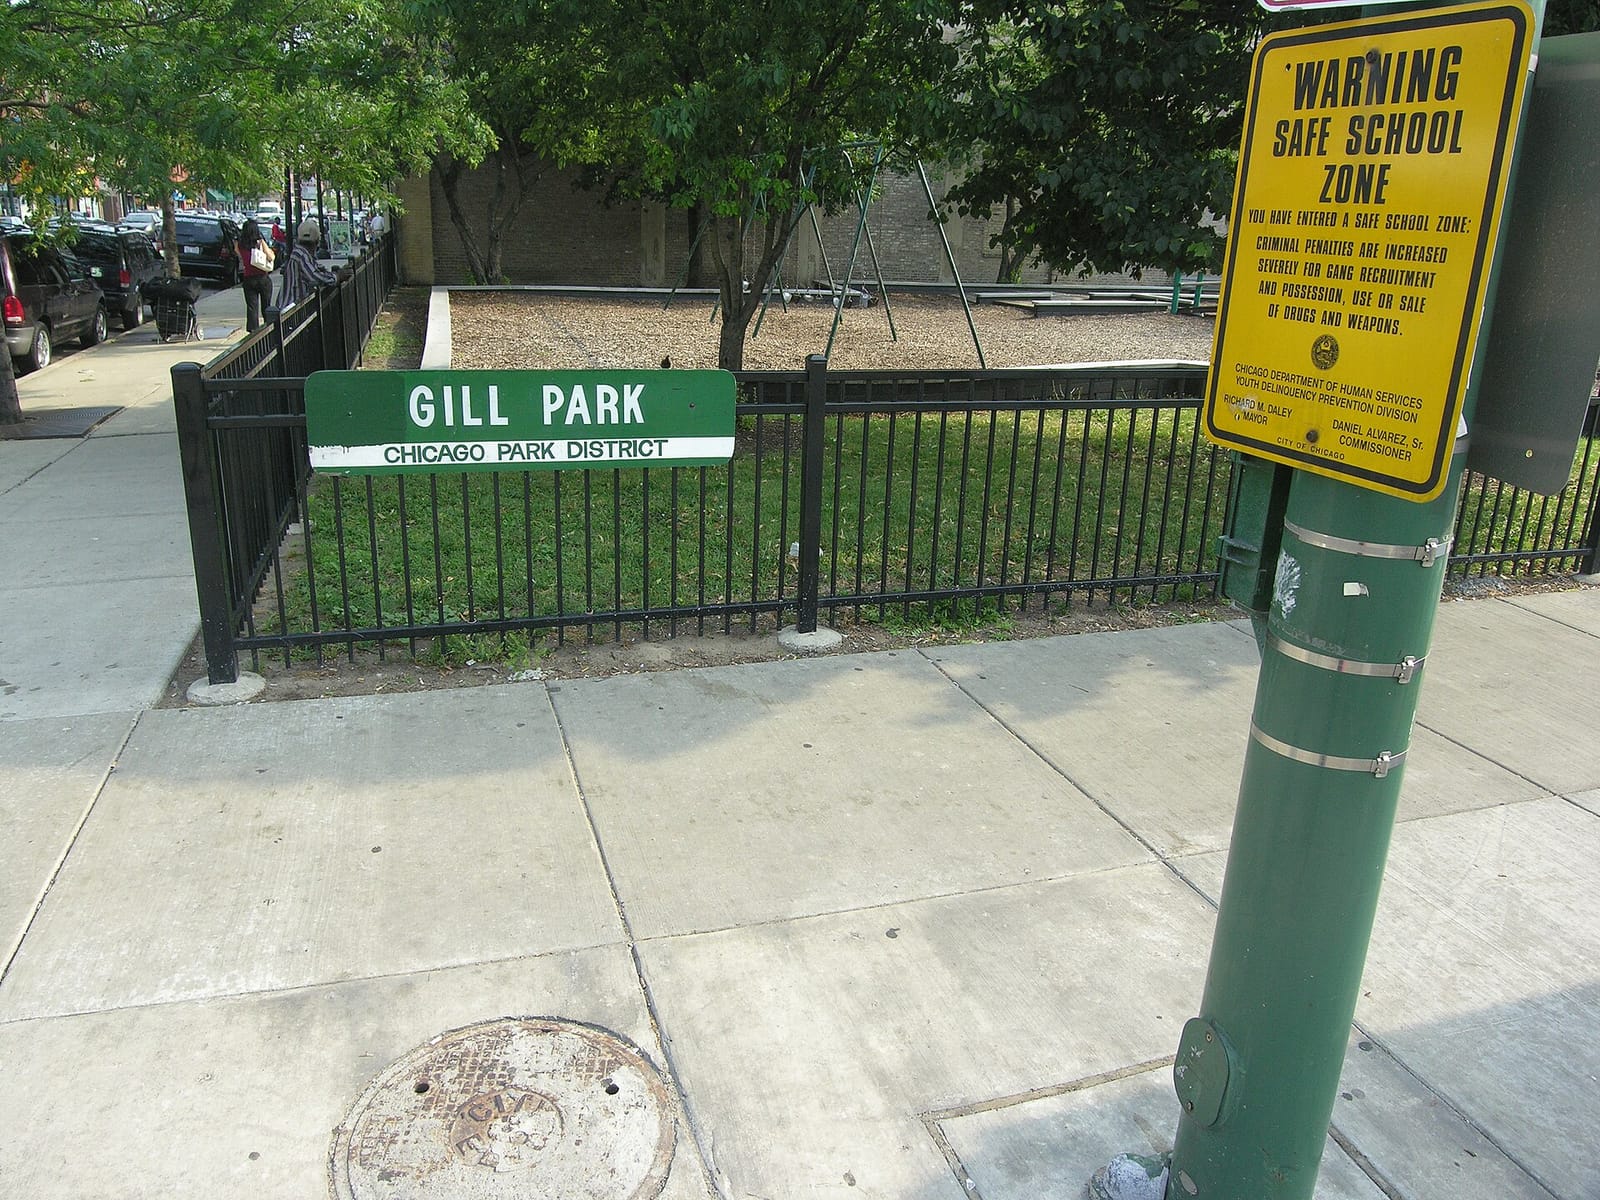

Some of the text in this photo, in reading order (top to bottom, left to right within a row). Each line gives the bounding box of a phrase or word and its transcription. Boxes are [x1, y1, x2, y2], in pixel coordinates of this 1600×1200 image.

[1293, 46, 1463, 110] WARNING
[1273, 110, 1464, 157] SAFE SCHOOL
[1319, 164, 1391, 204] ZONE
[1248, 209, 1472, 234] YOU HAVE ENTERED A SAFE SCHOOL ZONE:
[1256, 236, 1448, 264] CRIMINAL PENALTIES ARE INCREASED
[1258, 258, 1436, 289] SEVERELY FOR GANG RECRUITMENT
[1258, 280, 1426, 313] AND POSSESSION, USE OR SALE
[1268, 304, 1403, 336] OF DRUGS AND WEAPONS.
[1235, 363, 1423, 409] CHICAGO DEPARTMENT OF HUMAN SERVICES
[1235, 376, 1418, 424] YOUTH DELINQUENCY PREVENTION DIVISION
[409, 384, 645, 428] GILL PARK
[1223, 394, 1293, 419] RICHARD M. DALEY
[1243, 411, 1268, 425] MAYOR
[1276, 436, 1345, 461] CITY OF CHICAGO
[1332, 419, 1424, 450] DANIEL ALVAREZ, Sr.
[1339, 434, 1412, 462] COMMISSIONER
[384, 439, 668, 464] CHICAGO PARK DISTRICT
